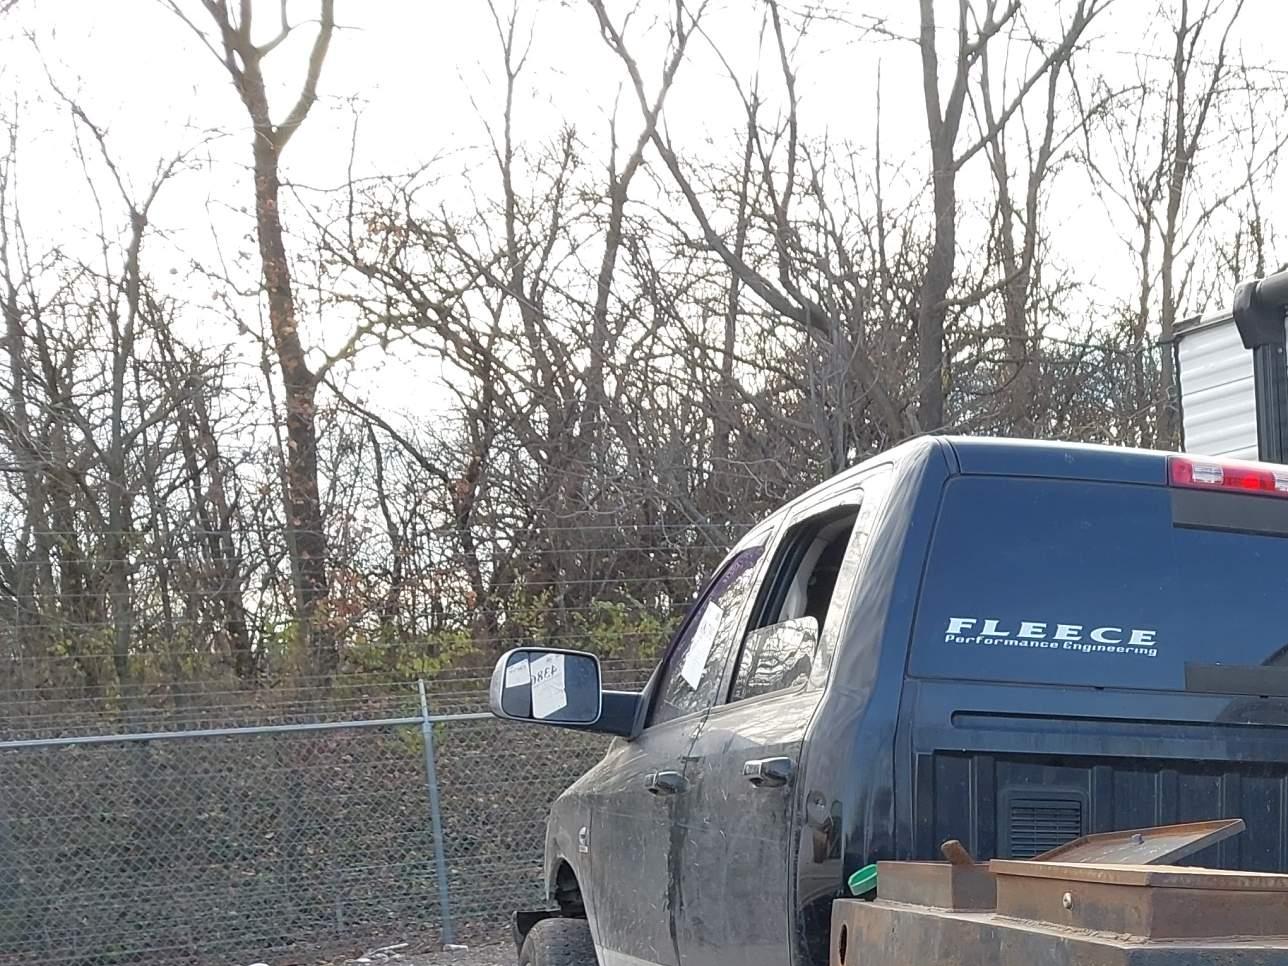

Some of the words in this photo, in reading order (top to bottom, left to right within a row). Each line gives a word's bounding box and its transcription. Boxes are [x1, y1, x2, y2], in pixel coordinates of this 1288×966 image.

[945, 617, 1156, 645] FLEECE
[945, 634, 1059, 649] Performance
[1063, 640, 1157, 657] Engineering
